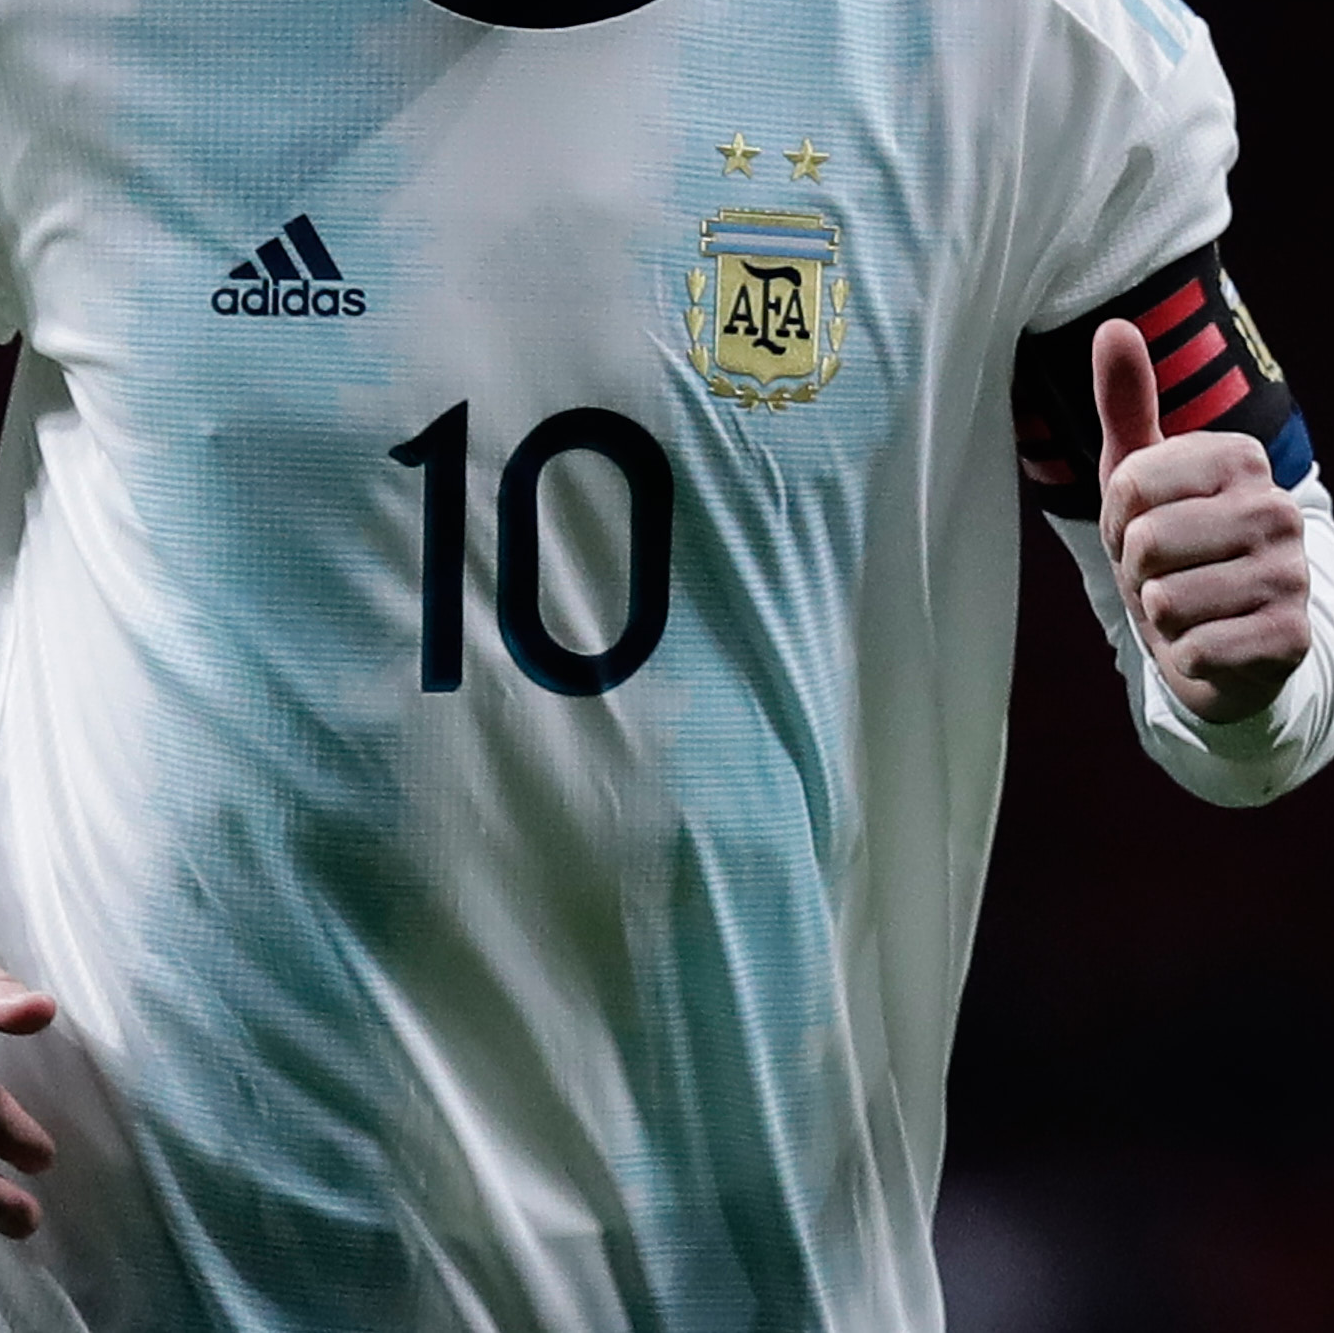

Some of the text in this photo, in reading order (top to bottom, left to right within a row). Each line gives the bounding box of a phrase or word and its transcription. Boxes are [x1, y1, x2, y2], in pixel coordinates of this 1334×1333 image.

[211, 279, 366, 316] adidas
[722, 260, 810, 355] AFA
[388, 399, 675, 696] 10
